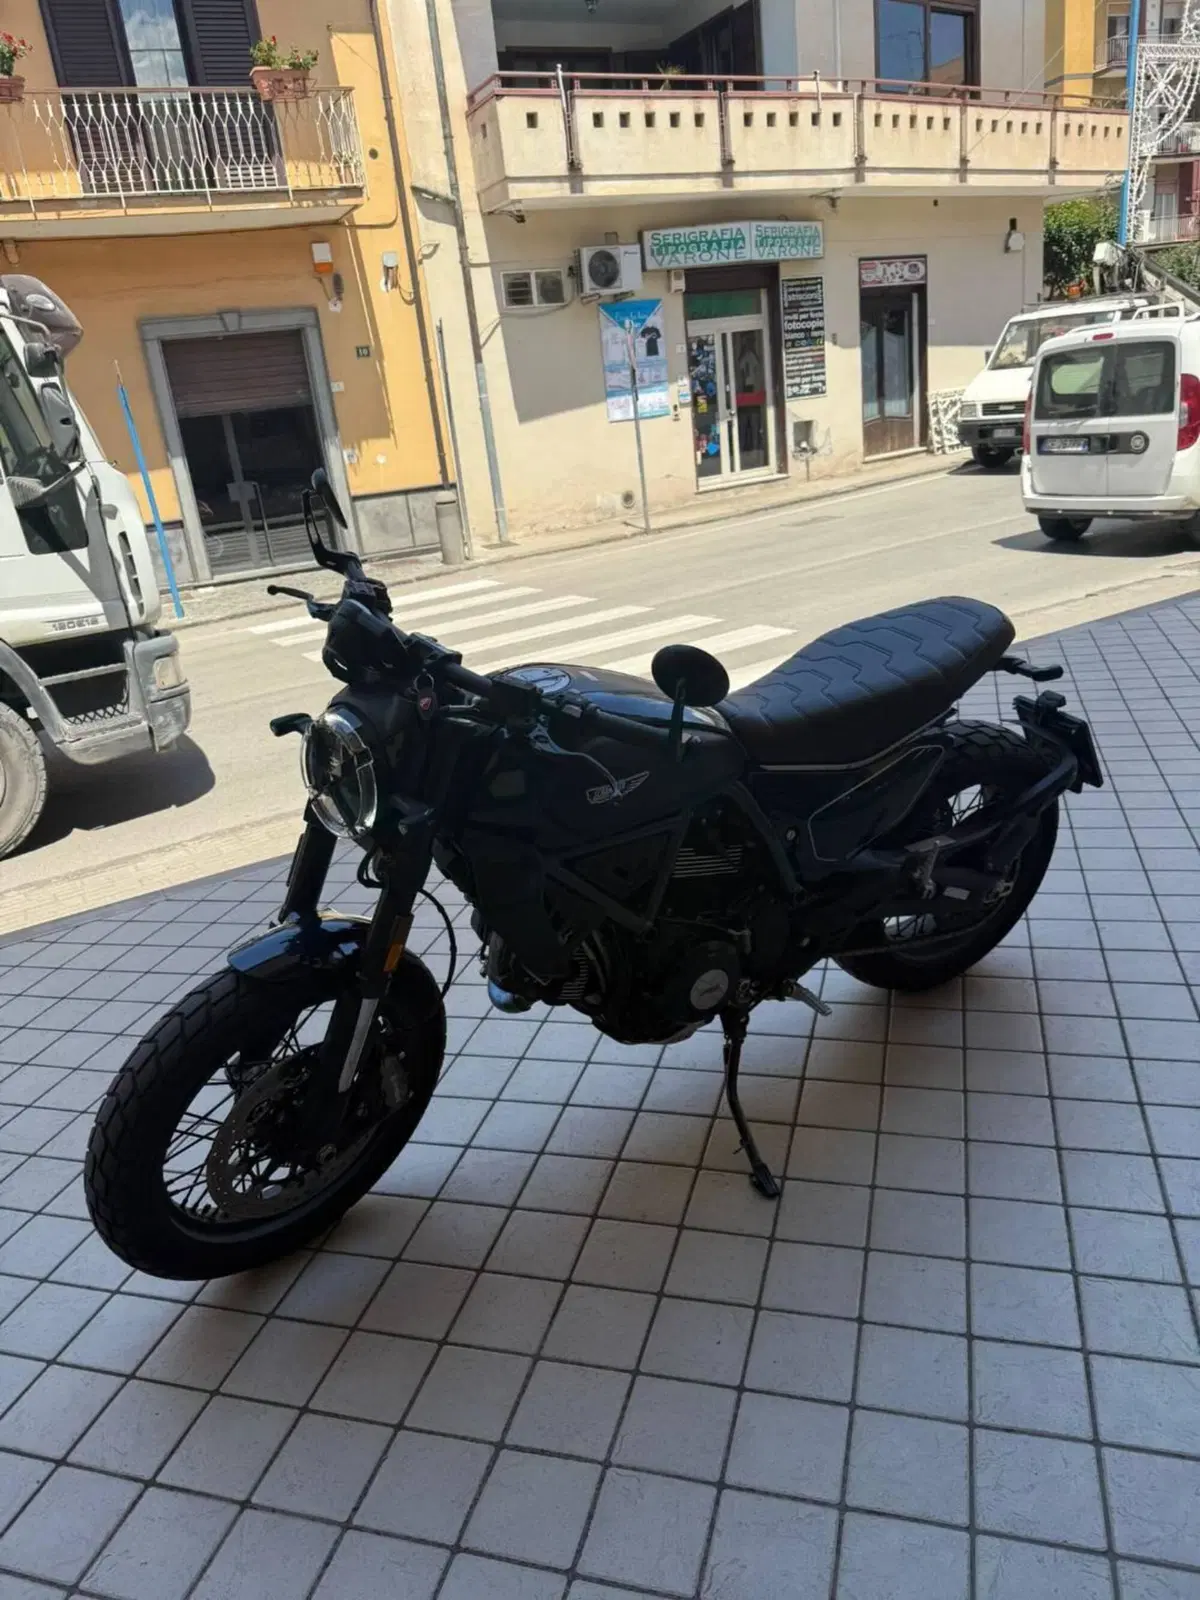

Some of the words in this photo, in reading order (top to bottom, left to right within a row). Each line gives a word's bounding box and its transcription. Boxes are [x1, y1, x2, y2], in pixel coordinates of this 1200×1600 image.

[651, 227, 745, 246] SERIGRAFIA
[755, 224, 820, 237] SERIGRAFIA
[652, 239, 746, 255] TIPOGRAFIA
[755, 236, 821, 248] TIPOGRAFIA
[651, 249, 747, 267] VARONE
[757, 246, 821, 258] VARONE
[784, 319, 824, 331] fotocopie
